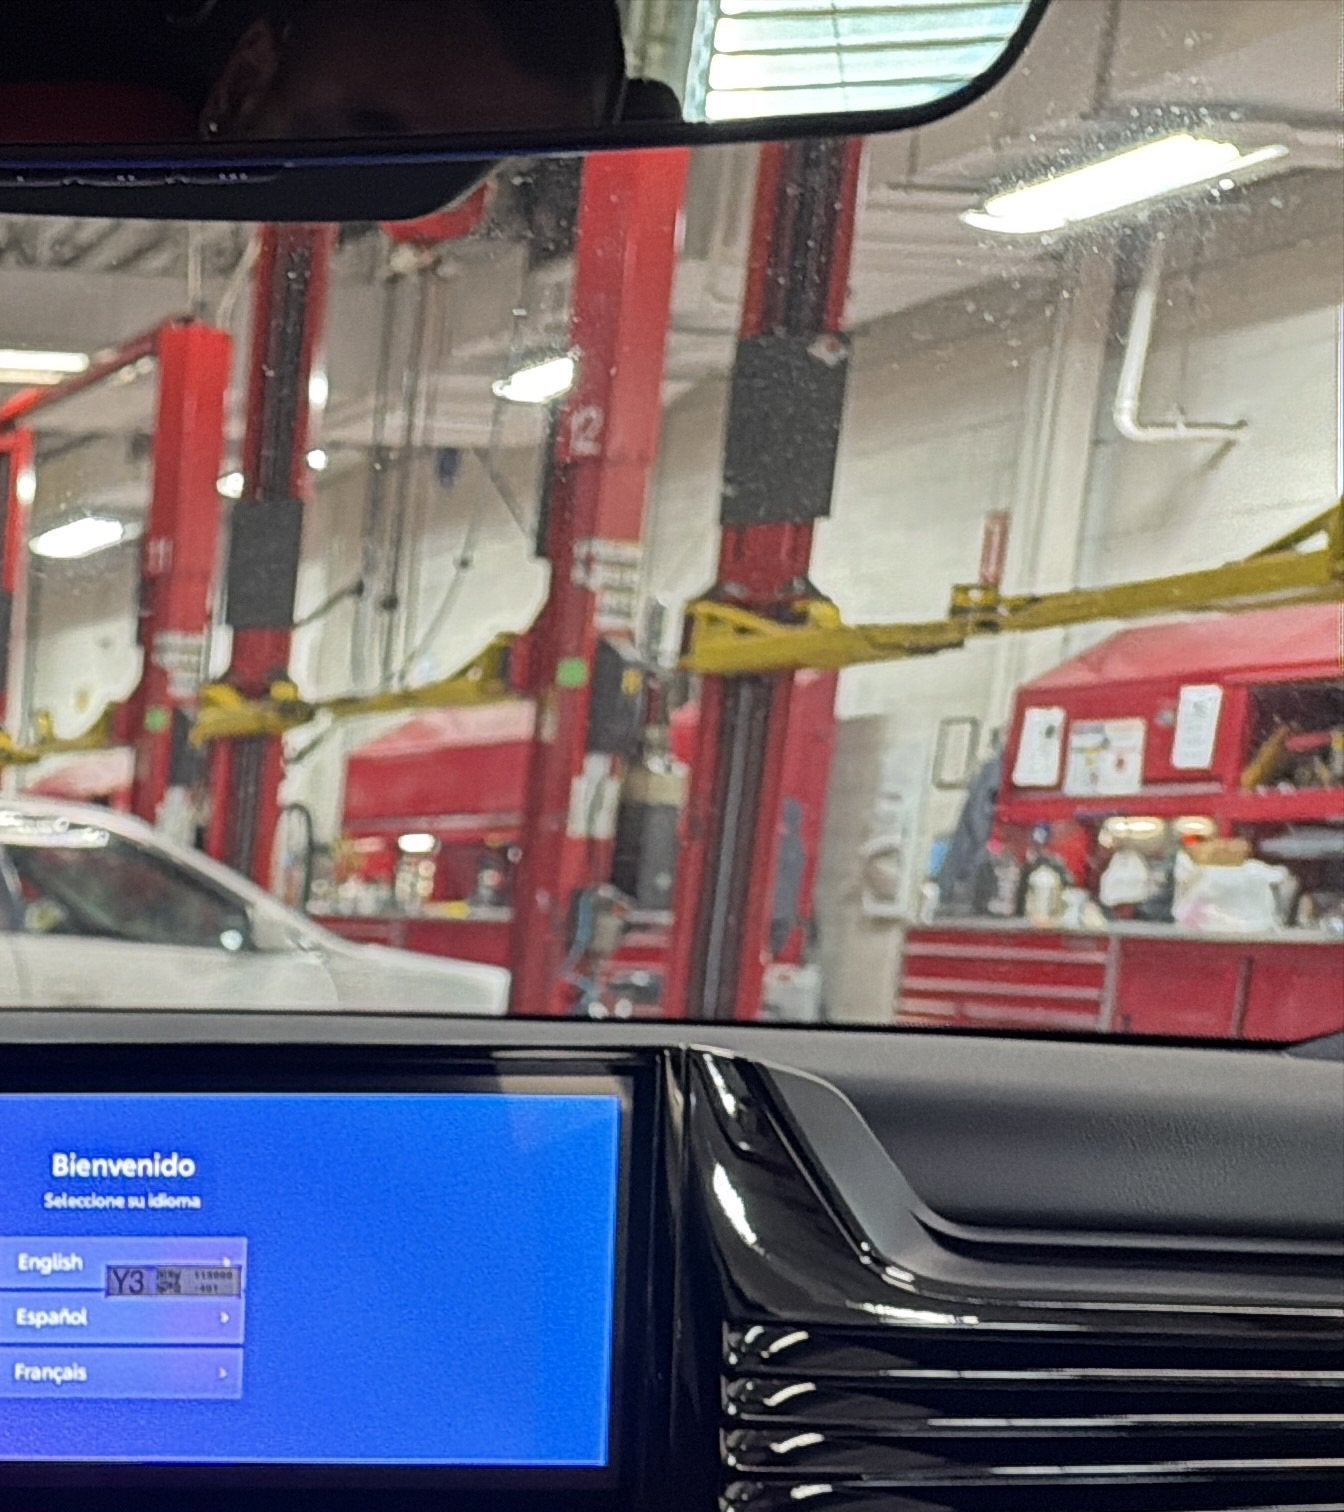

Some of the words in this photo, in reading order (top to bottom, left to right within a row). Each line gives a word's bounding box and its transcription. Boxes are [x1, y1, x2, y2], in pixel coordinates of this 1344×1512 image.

[52, 1152, 197, 1178] Bienvenido
[43, 1192, 126, 1210] Seleccione
[128, 1194, 146, 1209] su
[148, 1192, 202, 1209] idioma
[17, 1252, 84, 1276] English
[112, 1268, 145, 1296] Y3
[16, 1307, 88, 1329] Español
[14, 1363, 88, 1386] Français
